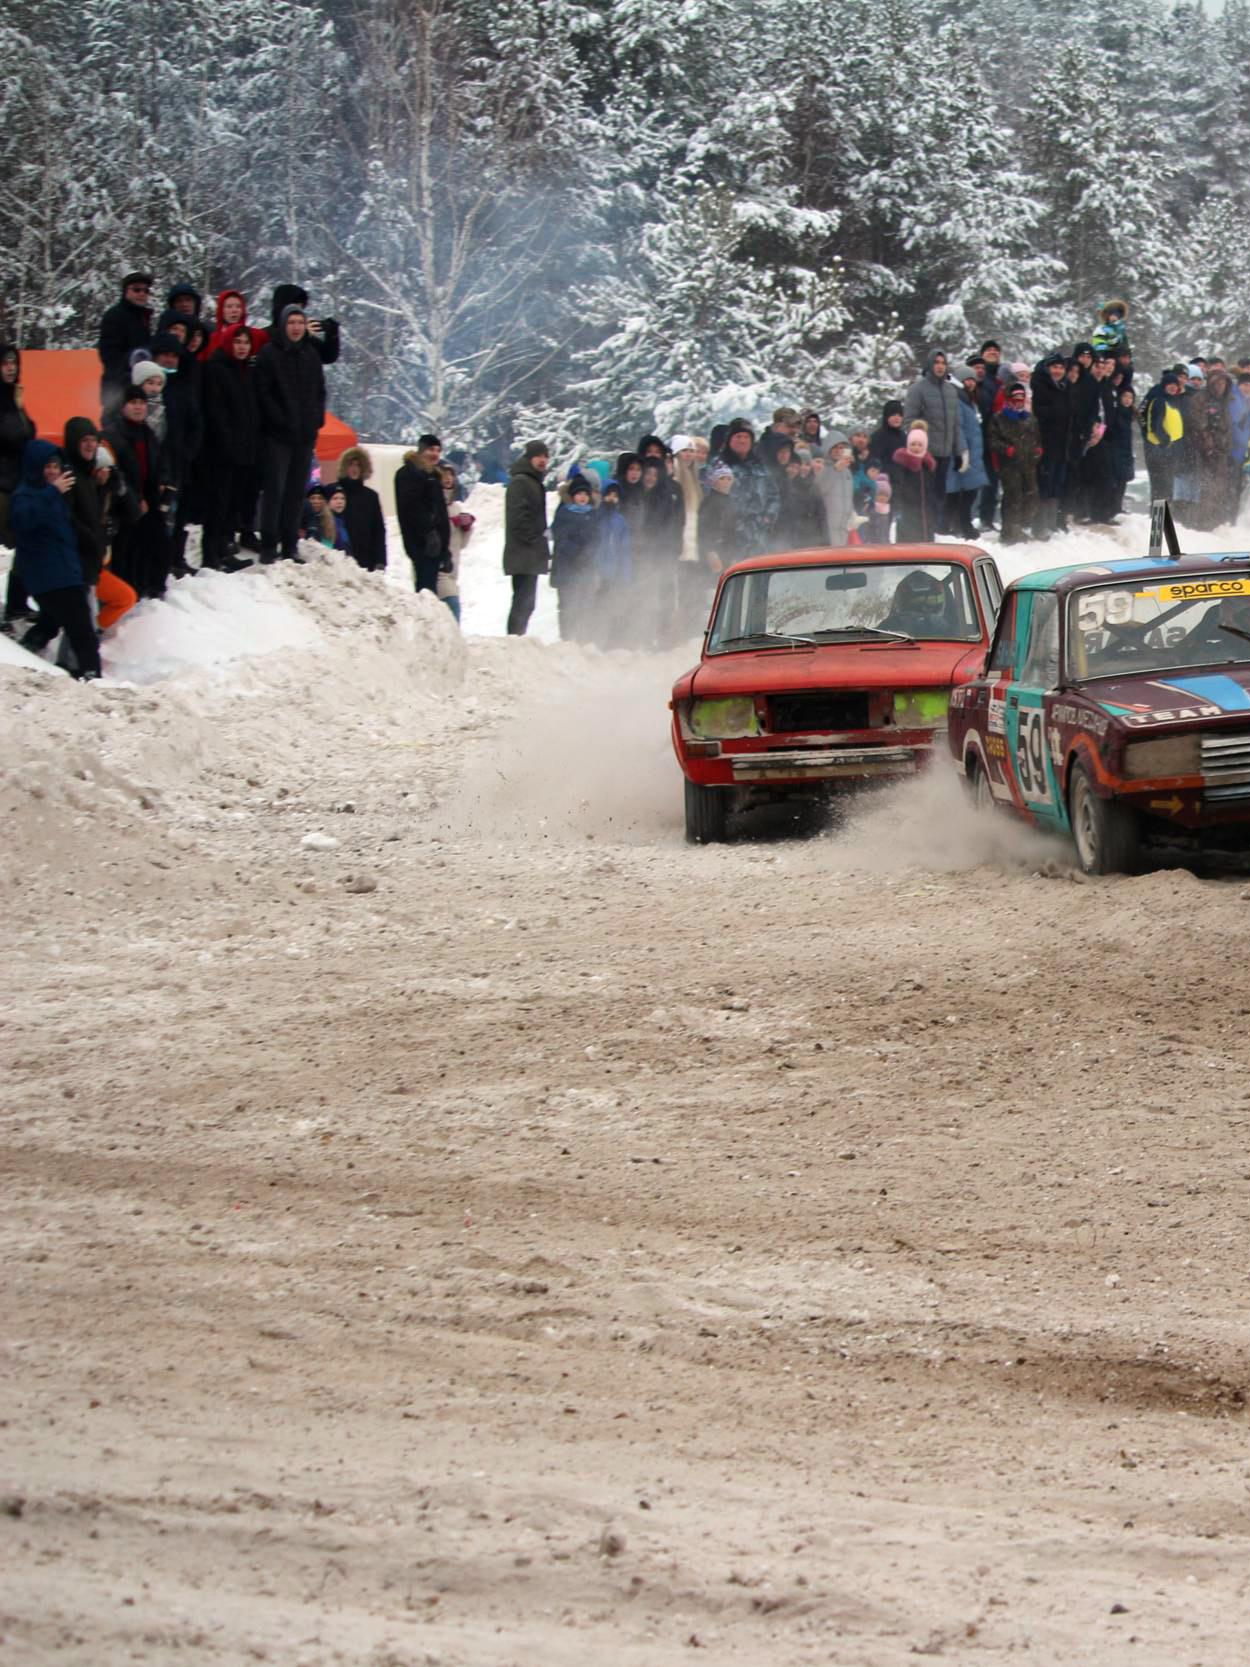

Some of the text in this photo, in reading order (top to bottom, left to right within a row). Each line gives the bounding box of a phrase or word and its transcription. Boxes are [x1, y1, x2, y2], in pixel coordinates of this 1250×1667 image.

[1170, 581, 1244, 599] sparco
[1078, 591, 1134, 631] 59
[1130, 706, 1223, 725] TEAM
[1018, 711, 1047, 795] 59
